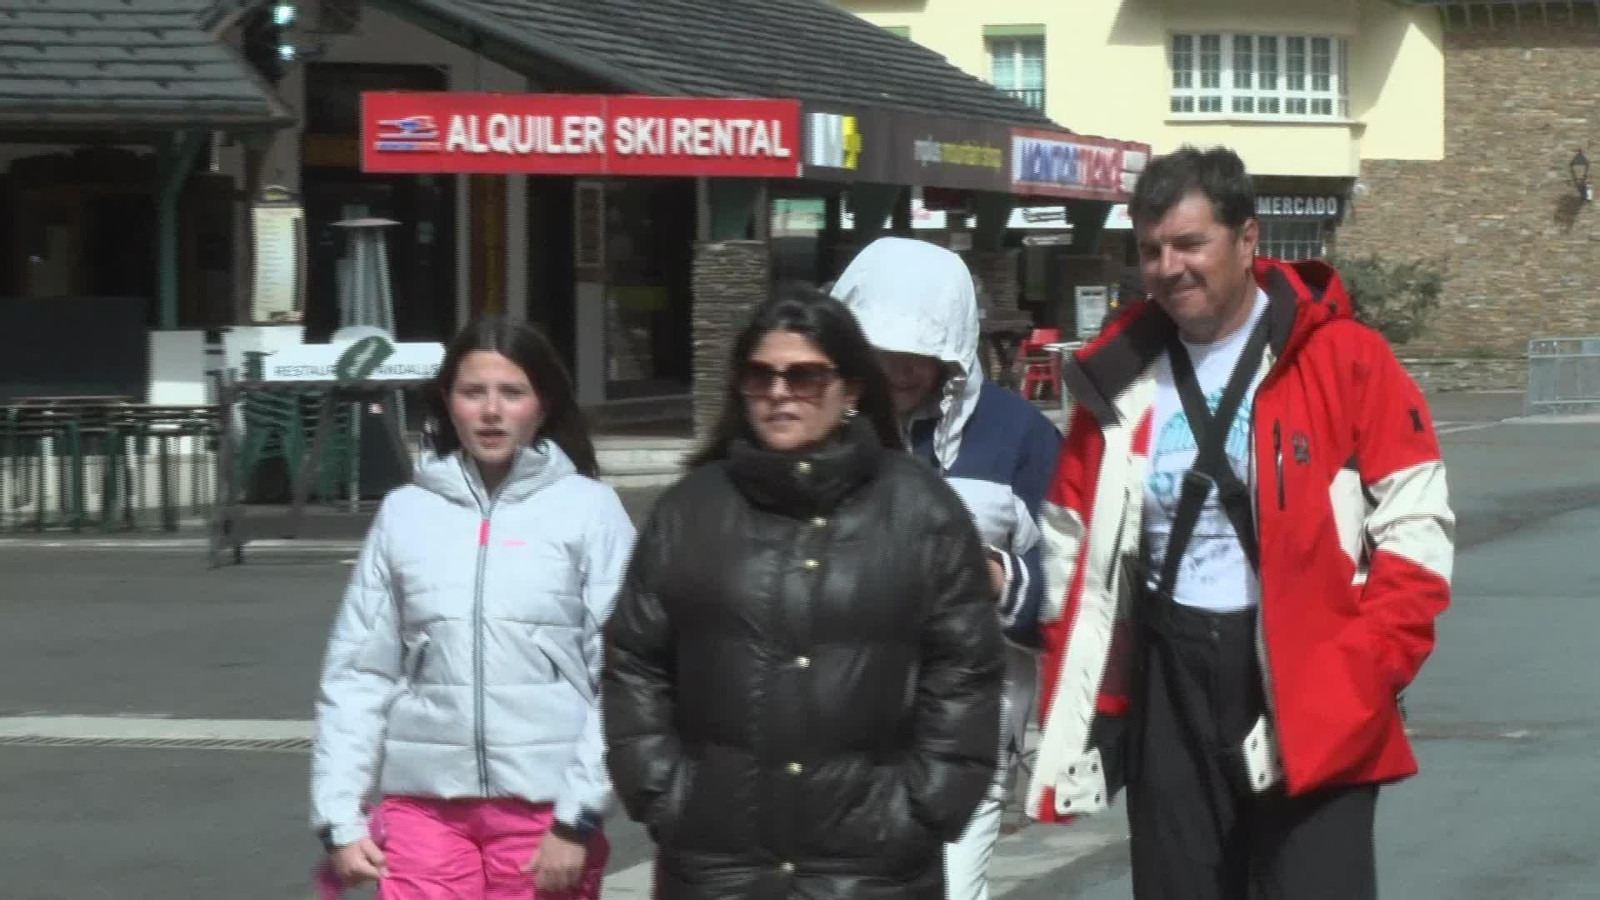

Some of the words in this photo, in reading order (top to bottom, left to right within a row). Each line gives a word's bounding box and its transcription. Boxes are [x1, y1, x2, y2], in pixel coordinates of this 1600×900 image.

[445, 113, 606, 155] ALQUILER
[613, 117, 668, 156] SKI
[671, 118, 791, 157] RENTAL
